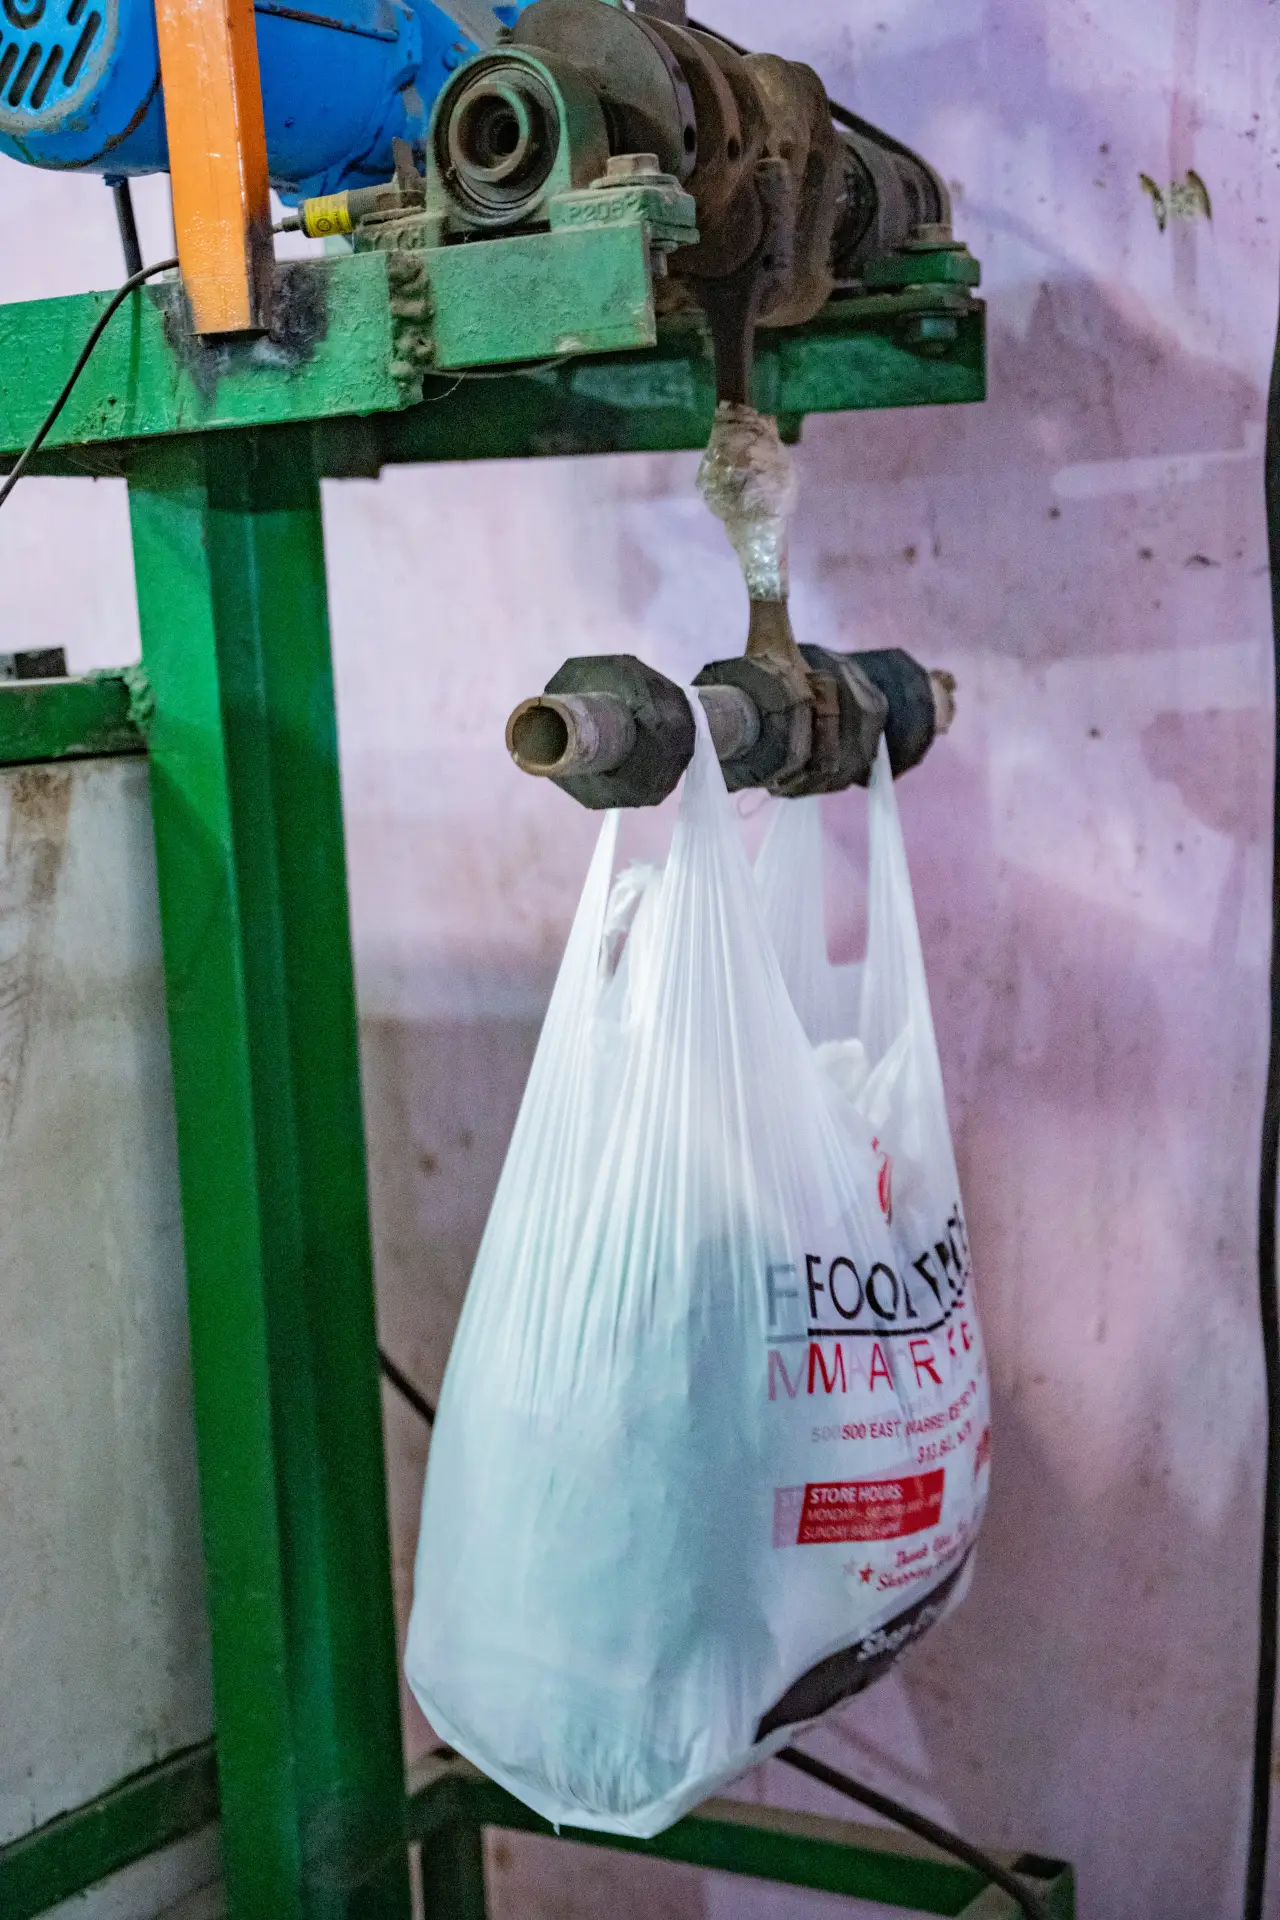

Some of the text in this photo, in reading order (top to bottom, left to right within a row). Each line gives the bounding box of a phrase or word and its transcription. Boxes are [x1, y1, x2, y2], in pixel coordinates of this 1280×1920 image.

[841, 1422, 867, 1441] 500
[870, 1419, 902, 1439] EAST
[810, 1486, 857, 1505] STORE
